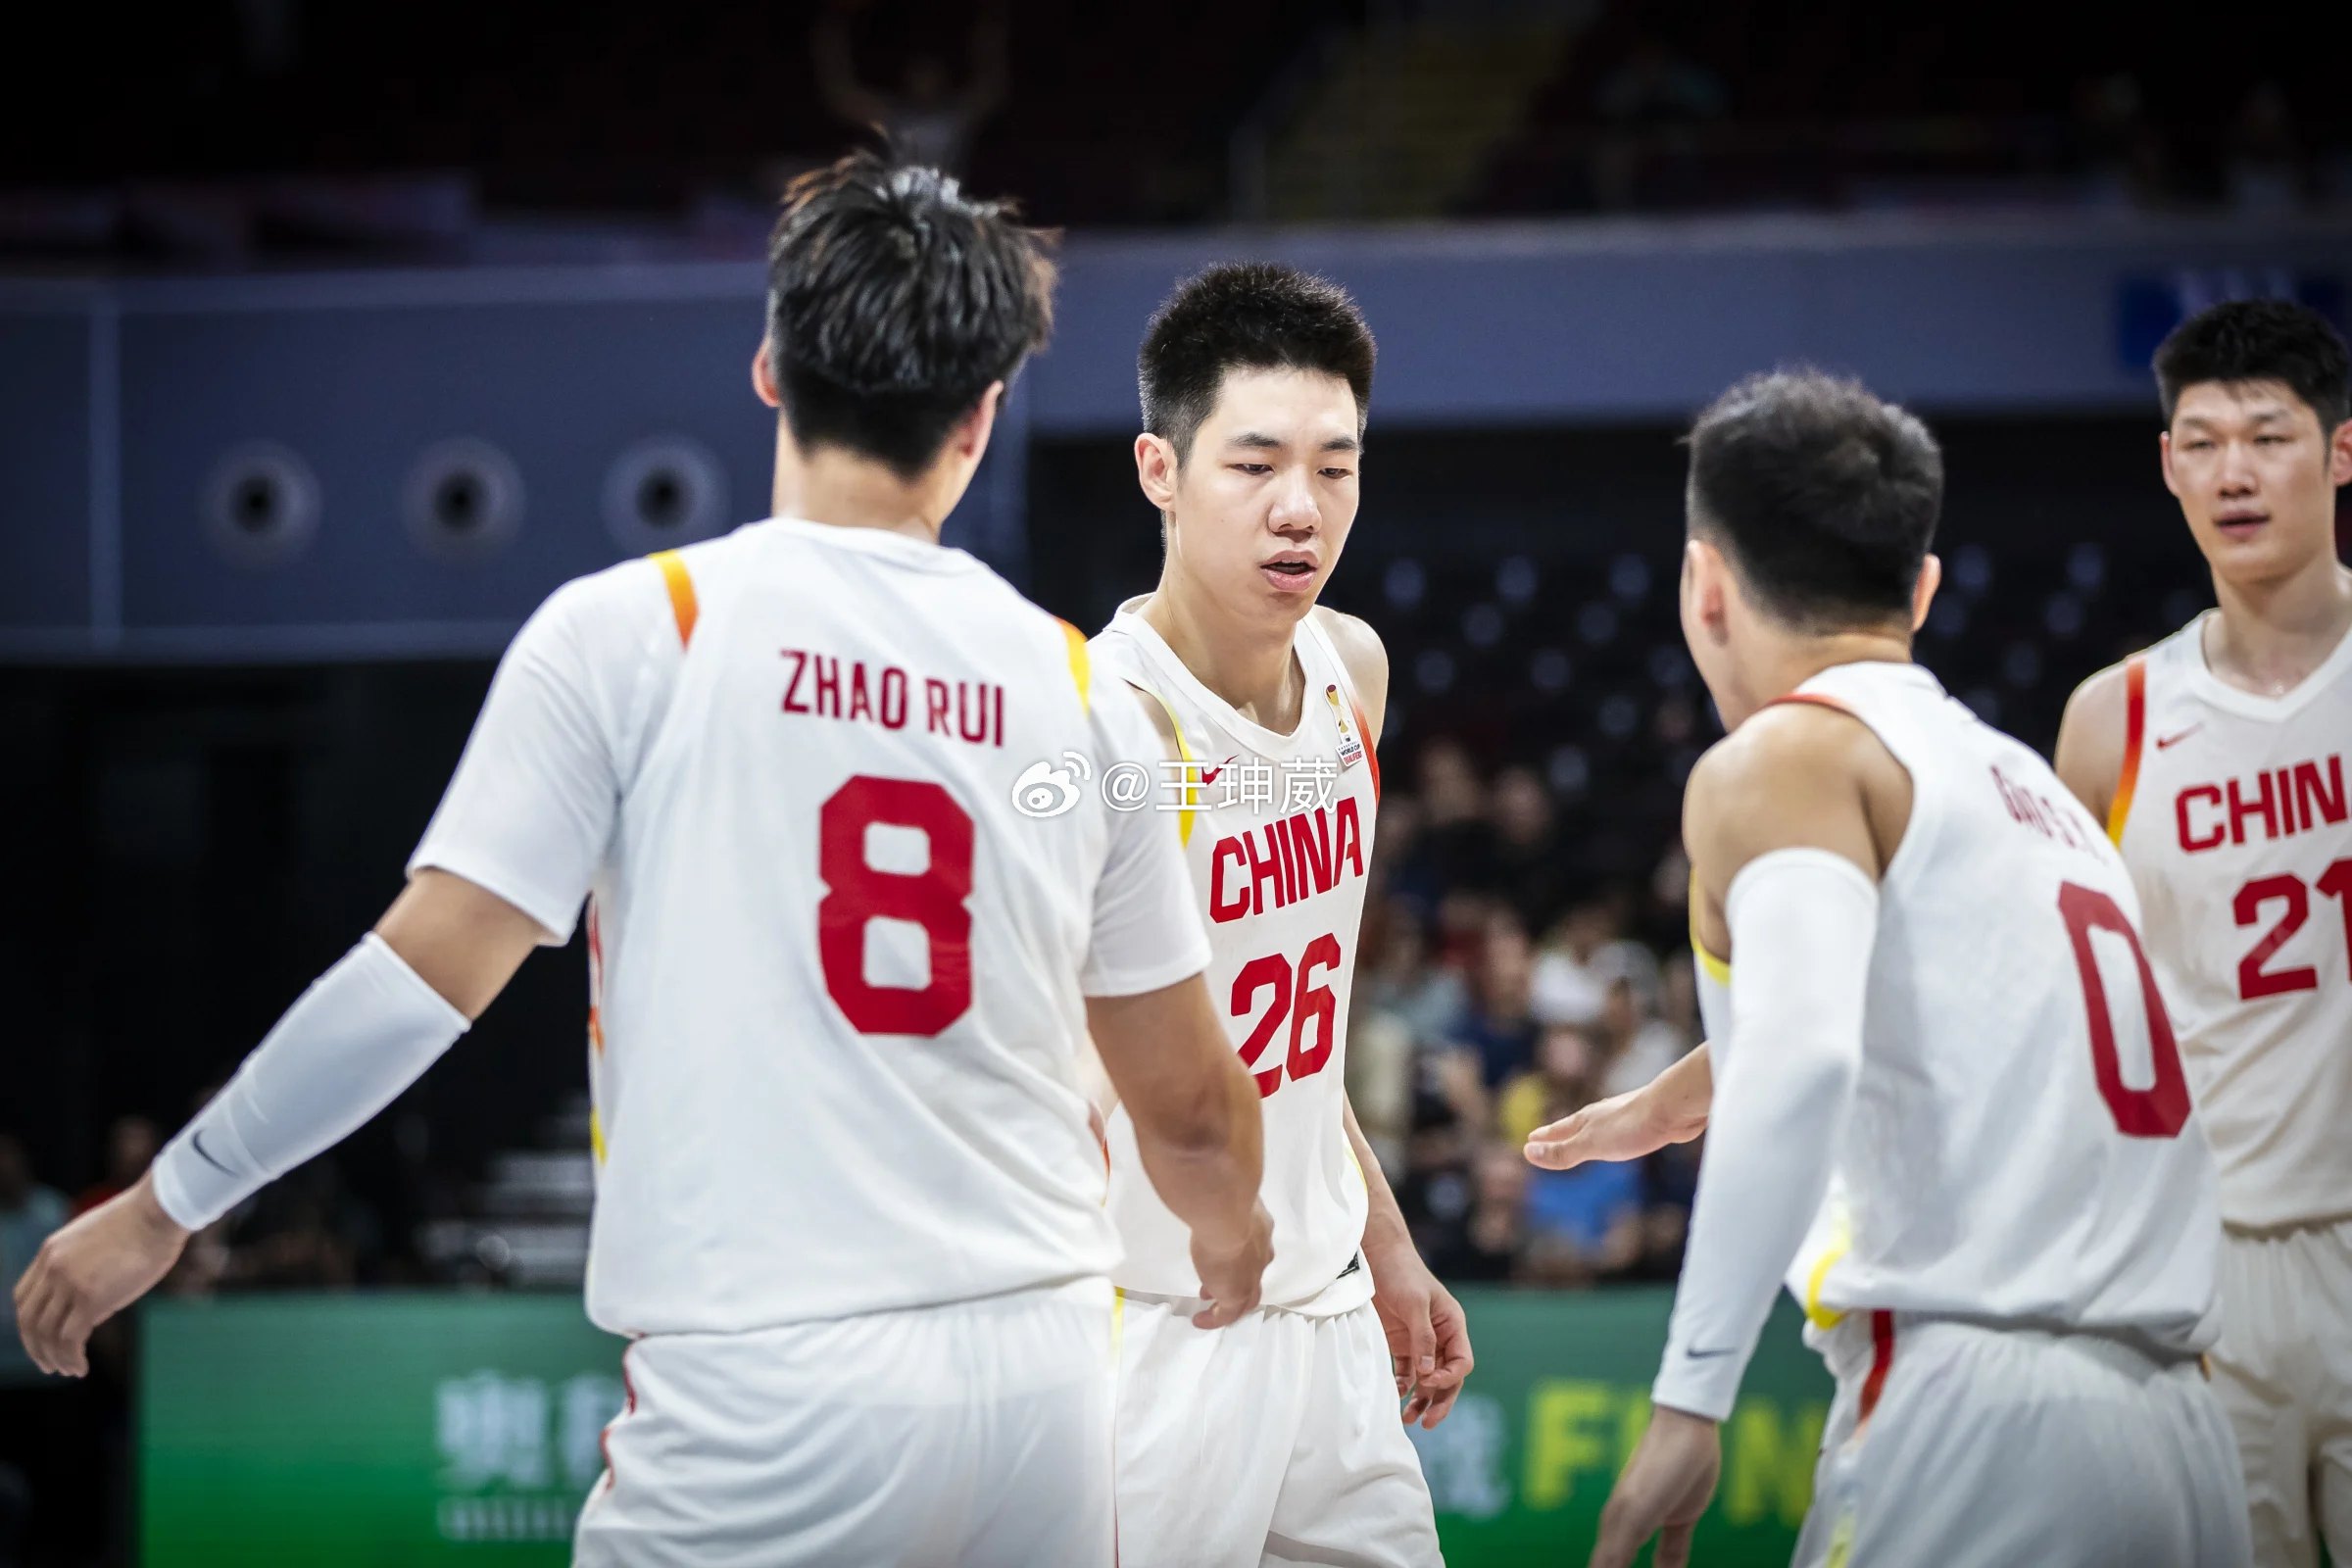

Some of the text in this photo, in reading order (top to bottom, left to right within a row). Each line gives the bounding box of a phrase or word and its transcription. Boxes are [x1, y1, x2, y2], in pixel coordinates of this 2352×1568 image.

[780, 649, 1005, 748] ZHAO RUI
[1209, 796, 1364, 923] CHINA
[2175, 753, 2352, 856] CHIN
[817, 774, 975, 1039] 8
[1230, 932, 1341, 1100] 26
[2057, 879, 2192, 1140] 0
